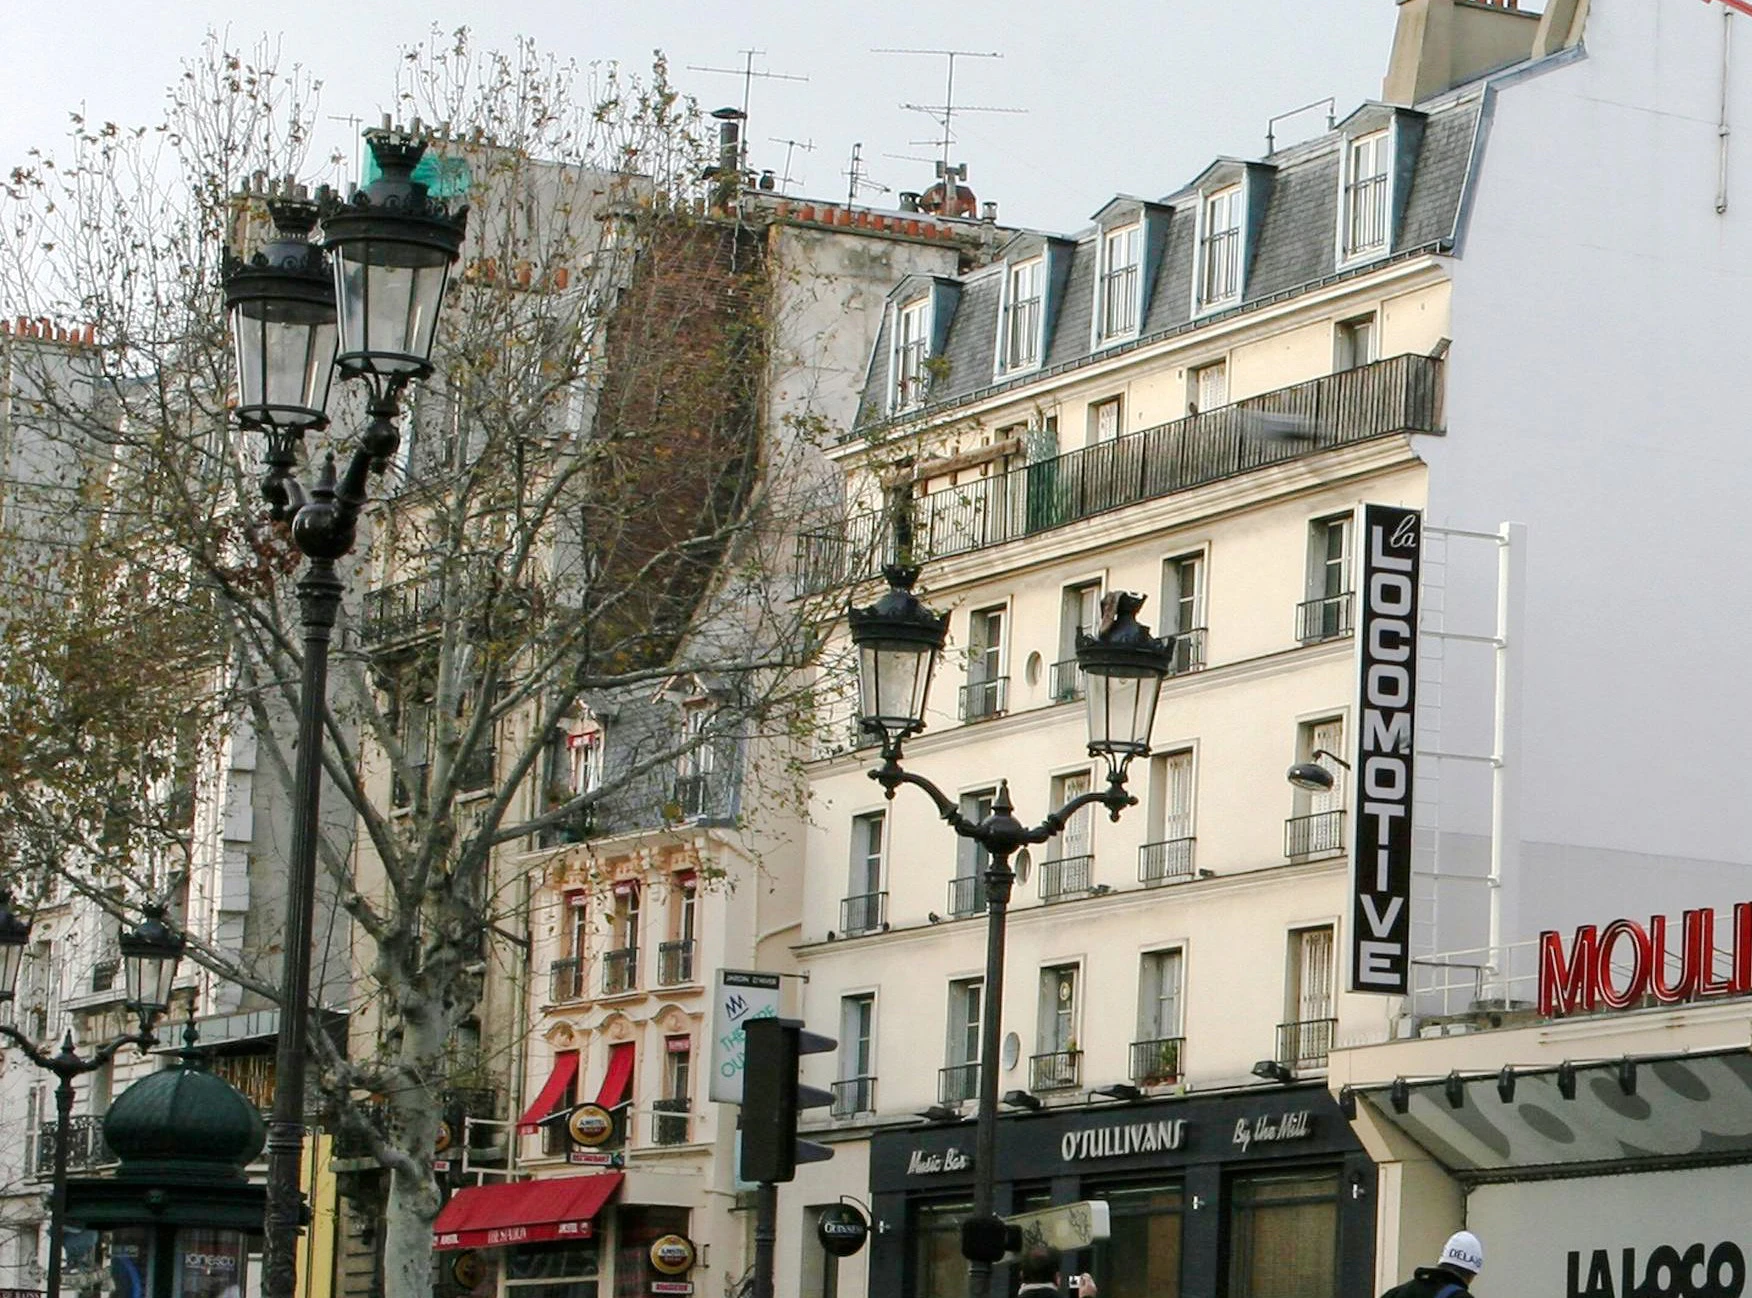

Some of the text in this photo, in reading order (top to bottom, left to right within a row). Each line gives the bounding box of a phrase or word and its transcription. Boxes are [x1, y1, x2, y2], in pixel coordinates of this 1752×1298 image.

[1390, 514, 1416, 548] la
[1360, 524, 1412, 985] LOCOMOTIVE
[1061, 1118, 1184, 1161] O'SULLIVANS
[1233, 1112, 1311, 1152] By the Mill
[1621, 1240, 1746, 1298] LOCO
